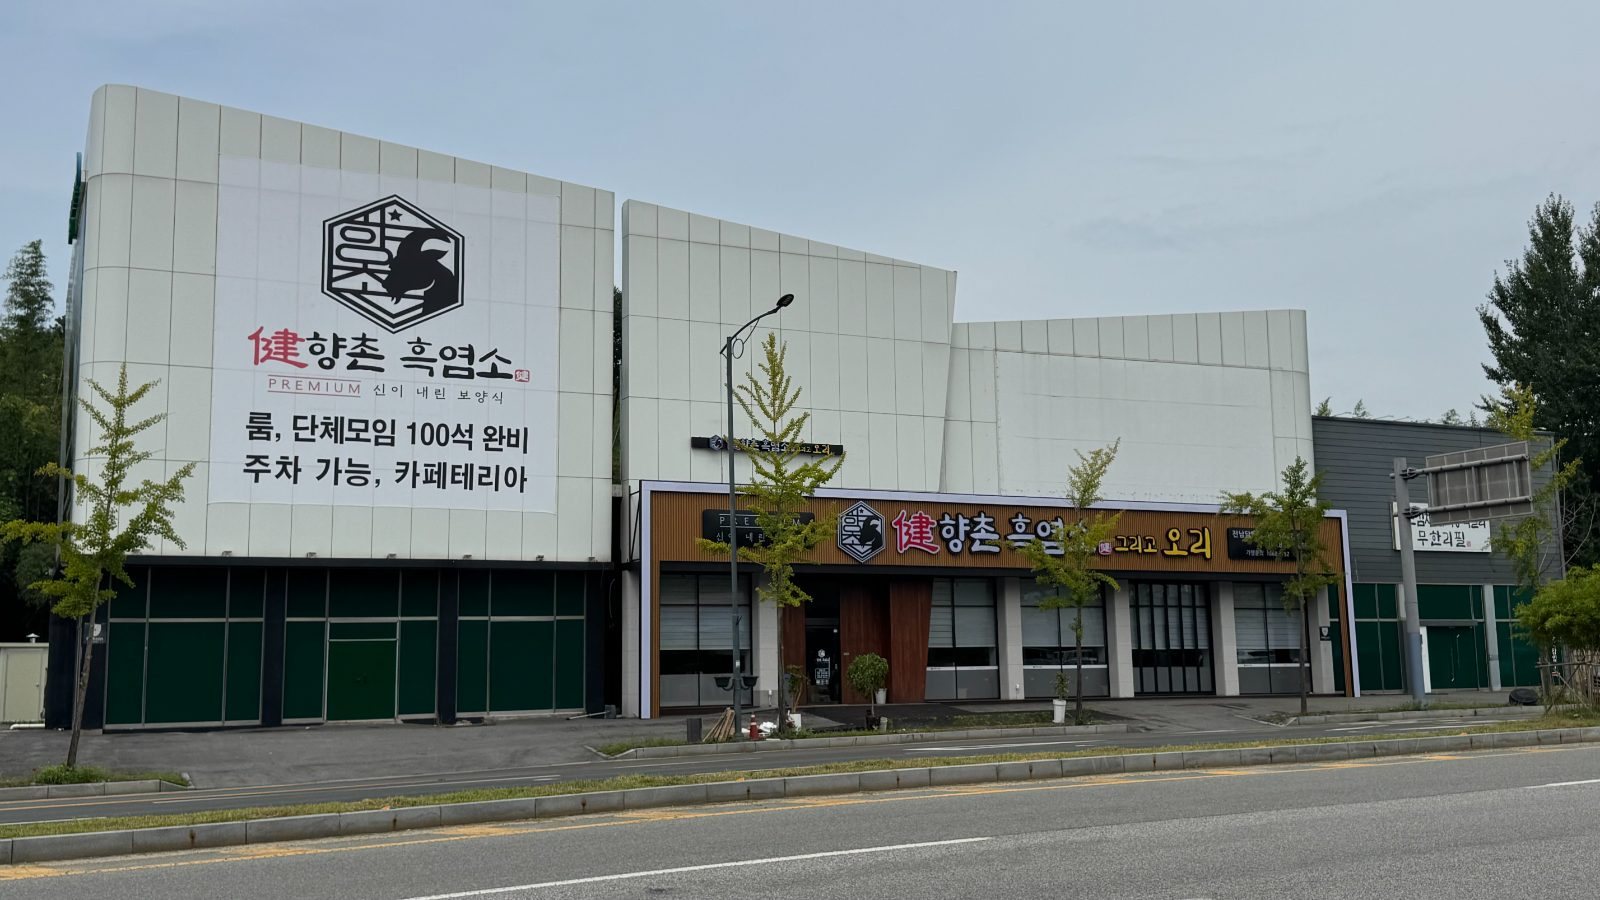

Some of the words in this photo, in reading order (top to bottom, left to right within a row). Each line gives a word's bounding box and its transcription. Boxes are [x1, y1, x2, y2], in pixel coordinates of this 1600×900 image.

[247, 326, 385, 373] 健향촌
[399, 336, 514, 380] 흑염소
[268, 378, 361, 394] PREMIUM
[373, 383, 404, 398] 신이
[416, 386, 446, 400] 내린
[457, 389, 504, 404] 보양식
[246, 412, 281, 442] 룸,
[292, 414, 396, 447] 단체모임
[407, 422, 474, 451] 100석
[482, 425, 529, 454] 완비
[813, 444, 831, 455] 오리
[243, 454, 302, 484] 주차
[315, 457, 381, 488] 가능,
[395, 460, 528, 493] 카페테리아
[892, 510, 1001, 554] 健향촌
[1006, 511, 1096, 556] 흑염
[1115, 535, 1158, 554] 그리고
[1162, 528, 1211, 560] 오리
[1417, 530, 1467, 547] 무한리필
